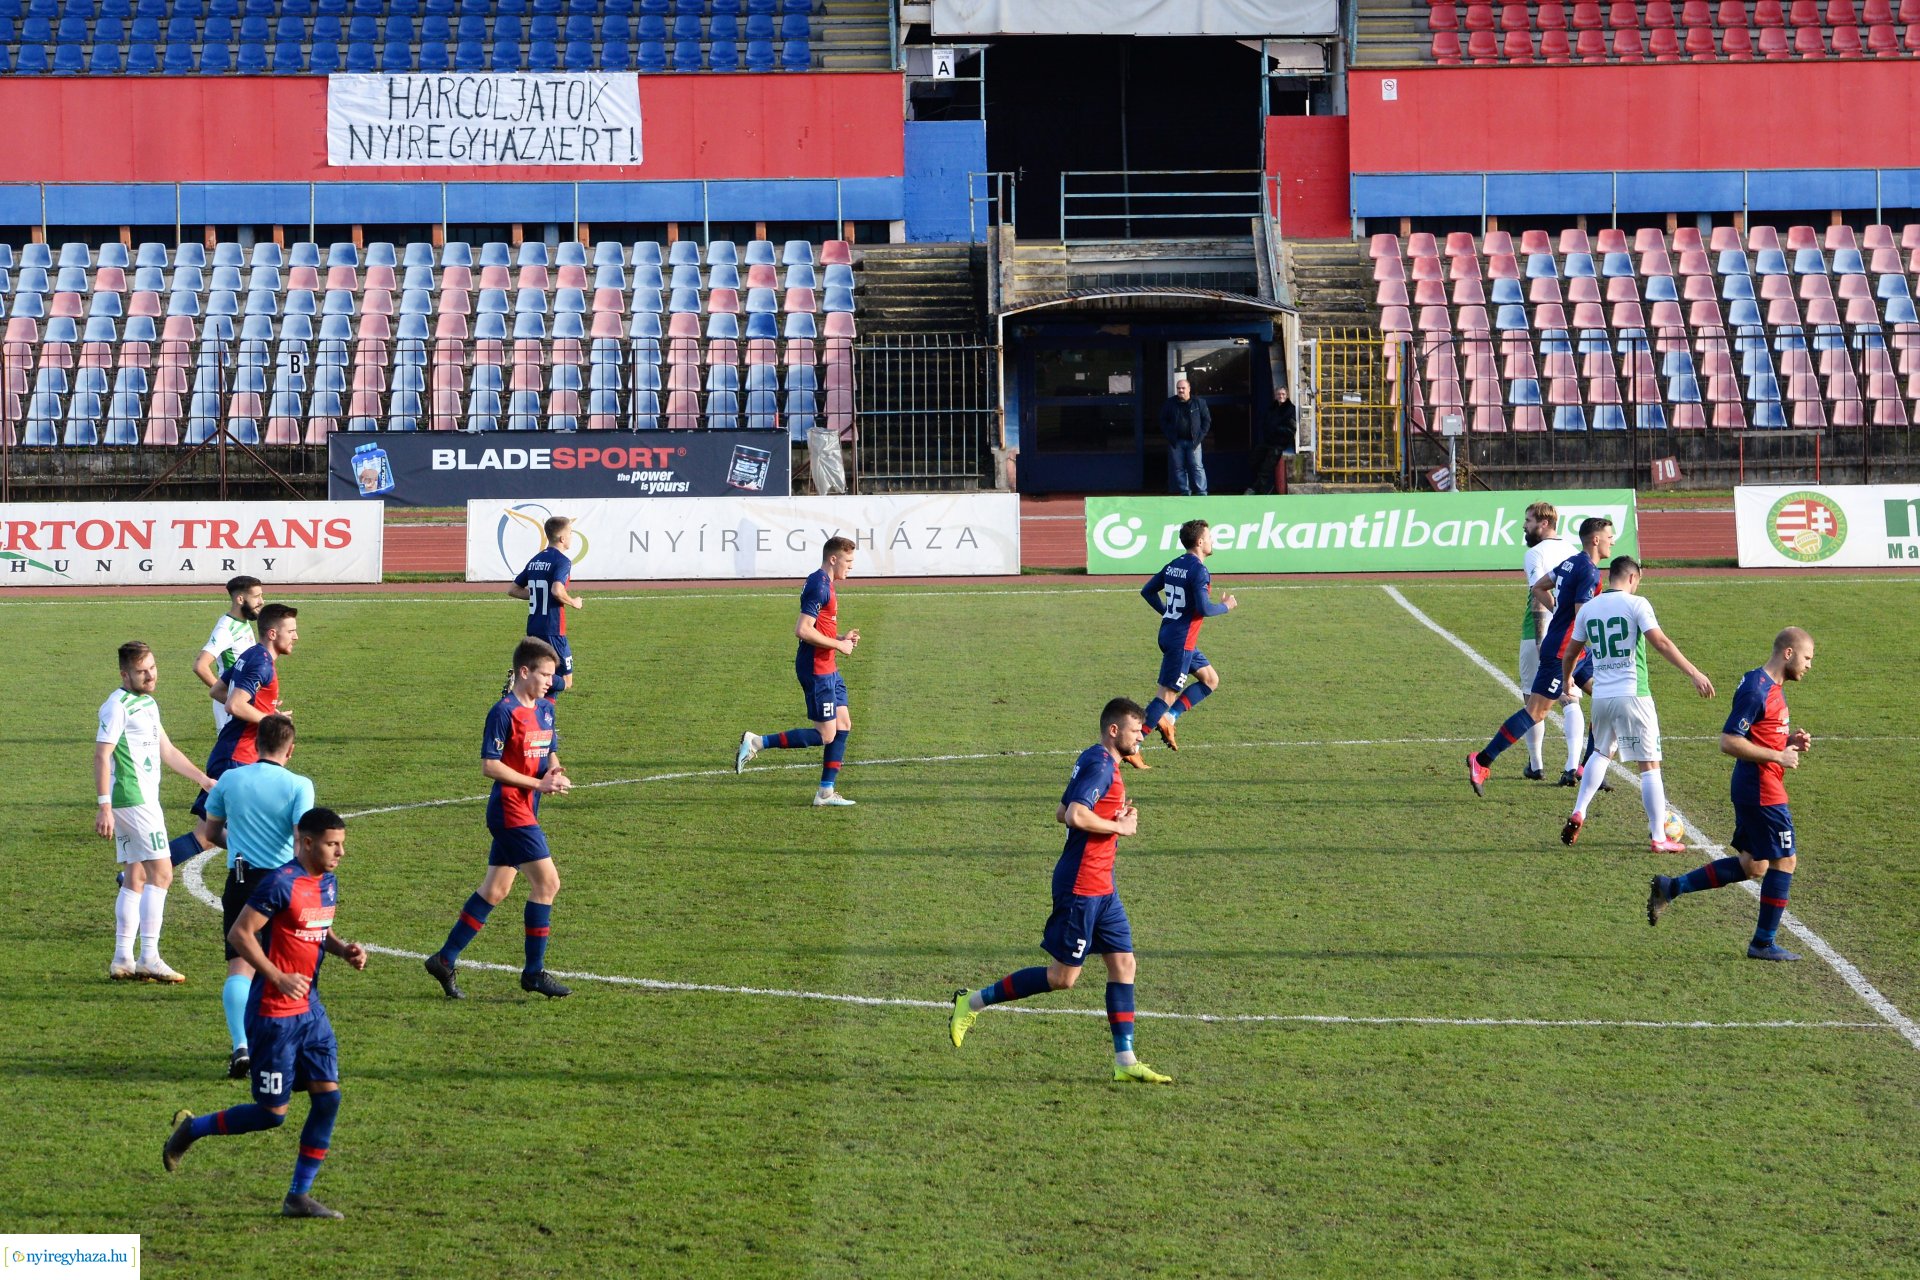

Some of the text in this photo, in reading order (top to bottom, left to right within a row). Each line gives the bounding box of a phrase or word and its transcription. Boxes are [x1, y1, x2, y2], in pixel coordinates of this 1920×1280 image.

[938, 61, 950, 75] A
[388, 76, 609, 123] HARCOLJATOK
[291, 355, 301, 373] B
[617, 470, 675, 484] the power
[1655, 459, 1675, 480] 70
[641, 481, 690, 495] is yours!
[171, 518, 352, 550] TRANS
[10, 558, 277, 573] HUNGARY
[1586, 616, 1631, 660] 92
[1548, 678, 1561, 694] 5
[823, 703, 834, 717] 21
[149, 831, 166, 851] 16
[1779, 831, 1792, 849] 15
[1072, 938, 1087, 958] 3
[260, 1071, 283, 1094] 30
